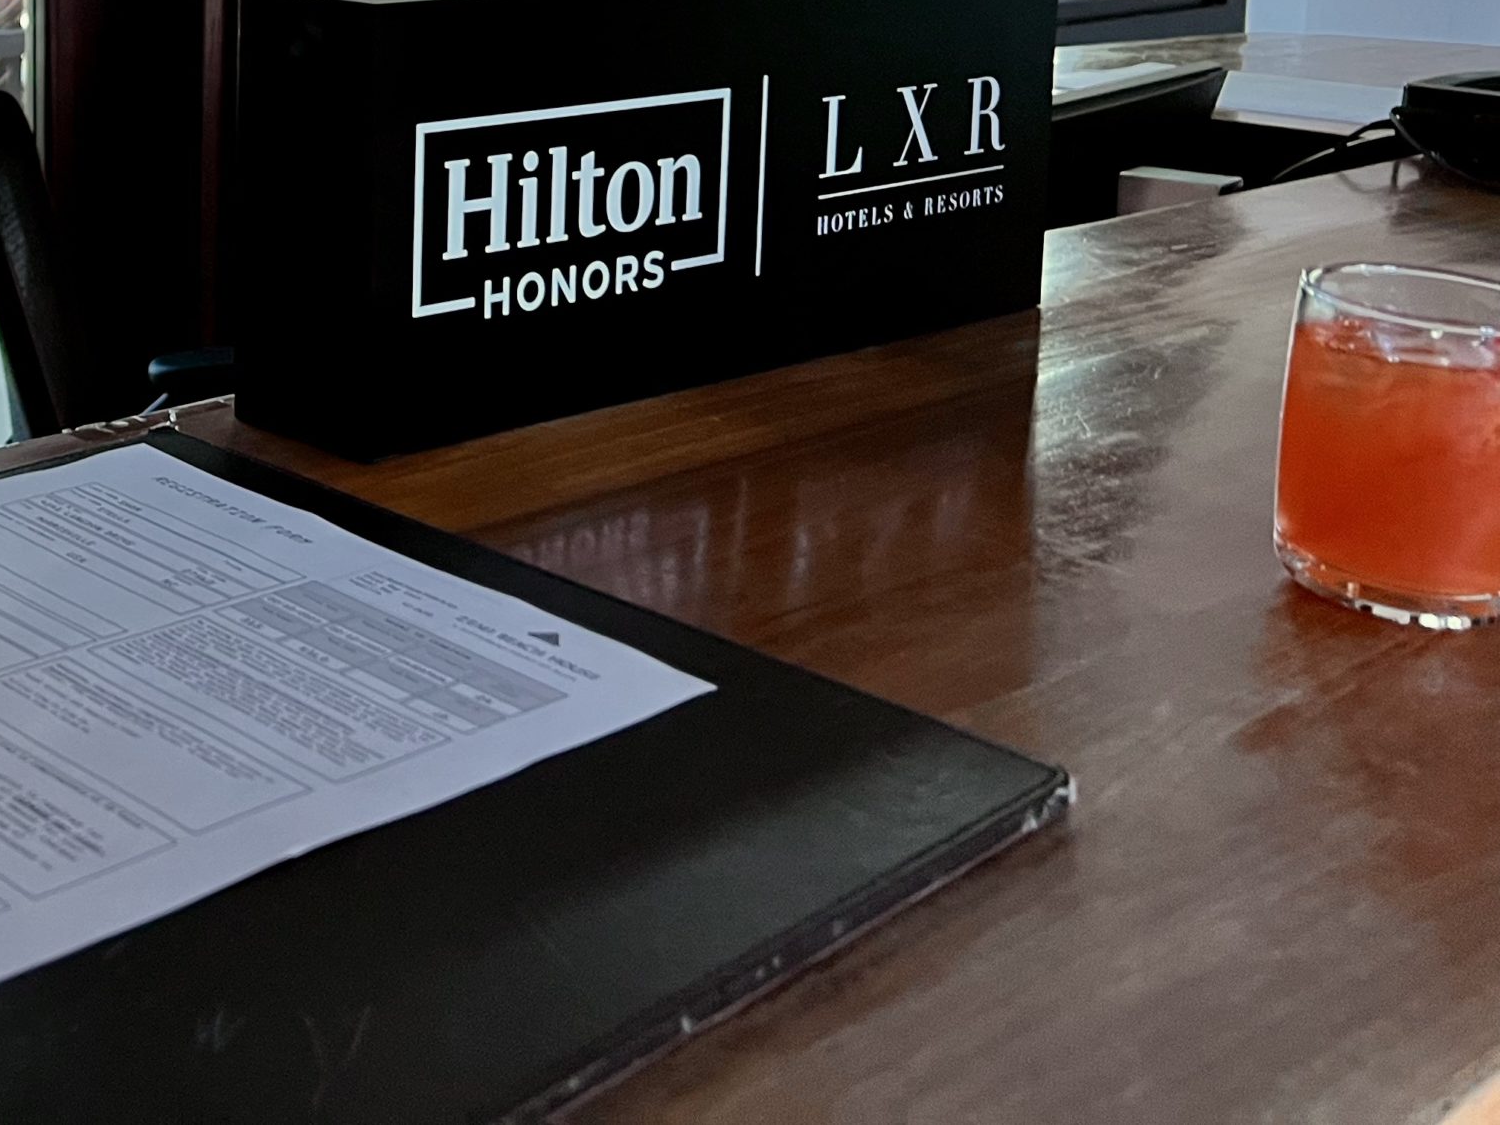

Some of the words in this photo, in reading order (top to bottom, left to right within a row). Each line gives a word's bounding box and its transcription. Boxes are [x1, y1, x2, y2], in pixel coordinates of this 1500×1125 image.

[442, 146, 703, 261] Hilton
[816, 203, 894, 236] HOTELS
[903, 201, 914, 220] &
[924, 184, 1004, 216] RESORTS
[483, 250, 665, 319] HONORS
